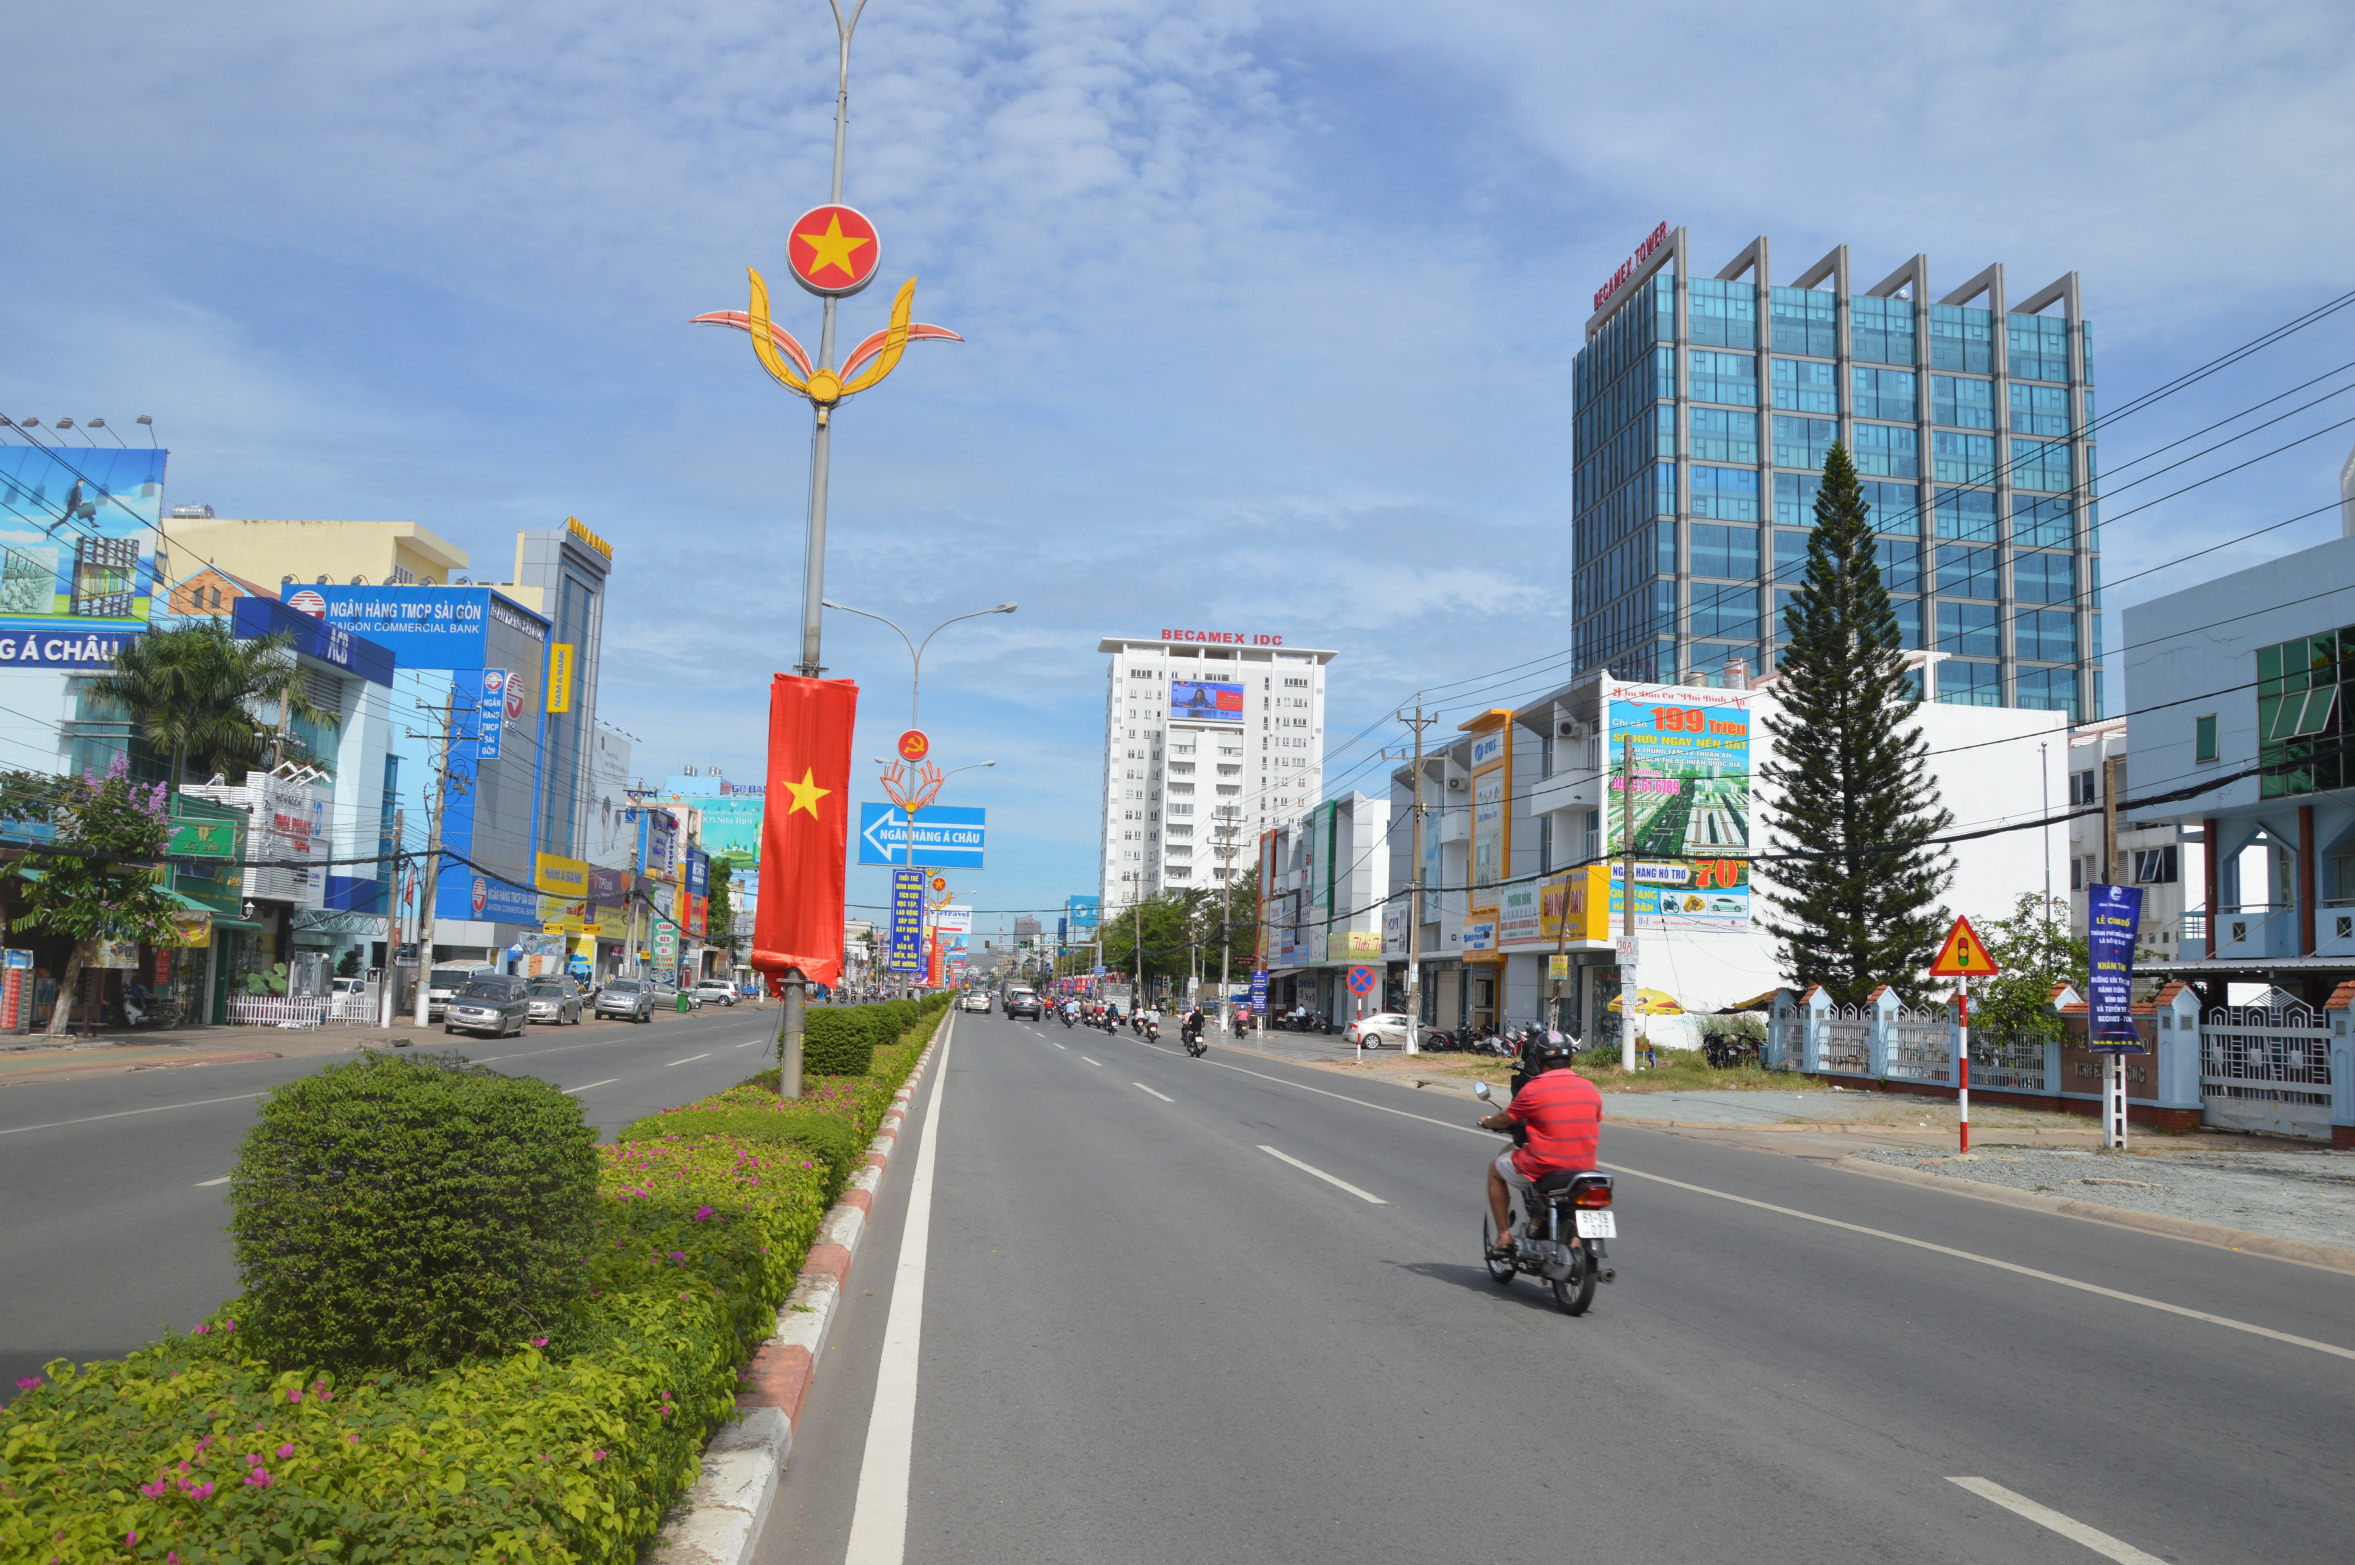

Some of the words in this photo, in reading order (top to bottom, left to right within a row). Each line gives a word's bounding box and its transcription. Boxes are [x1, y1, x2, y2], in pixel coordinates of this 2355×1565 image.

[1634, 220, 1668, 268] TOWER
[330, 598, 363, 617] NGÂN
[365, 599, 398, 619] HÀNG
[400, 603, 432, 619] TMCP
[434, 600, 453, 620] SÀI
[455, 601, 482, 620] GÒN
[374, 622, 447, 633] COMMERCIAL
[449, 623, 480, 634] BANK
[1161, 628, 1245, 644] BECAMEX
[1253, 634, 1283, 646] IDC
[20, 634, 40, 661] Á
[44, 634, 119, 662] CHÂU
[557, 649, 566, 676] BANK
[554, 685, 564, 708] NAM
[482, 723, 499, 732] TMCP
[1650, 706, 1705, 734] 199
[1707, 719, 1747, 737] Triệu
[1633, 733, 1658, 745] HỮU
[1661, 736, 1693, 747] NGAY
[1725, 737, 1748, 751] ĐẤT
[1642, 747, 1667, 755] TRUNG
[1721, 751, 1732, 759] AN
[1655, 779, 1680, 795] 6789
[880, 828, 908, 841] NGÂN
[912, 829, 942, 842] HÀNG
[943, 830, 950, 843] Á
[952, 831, 980, 844] CHÂU
